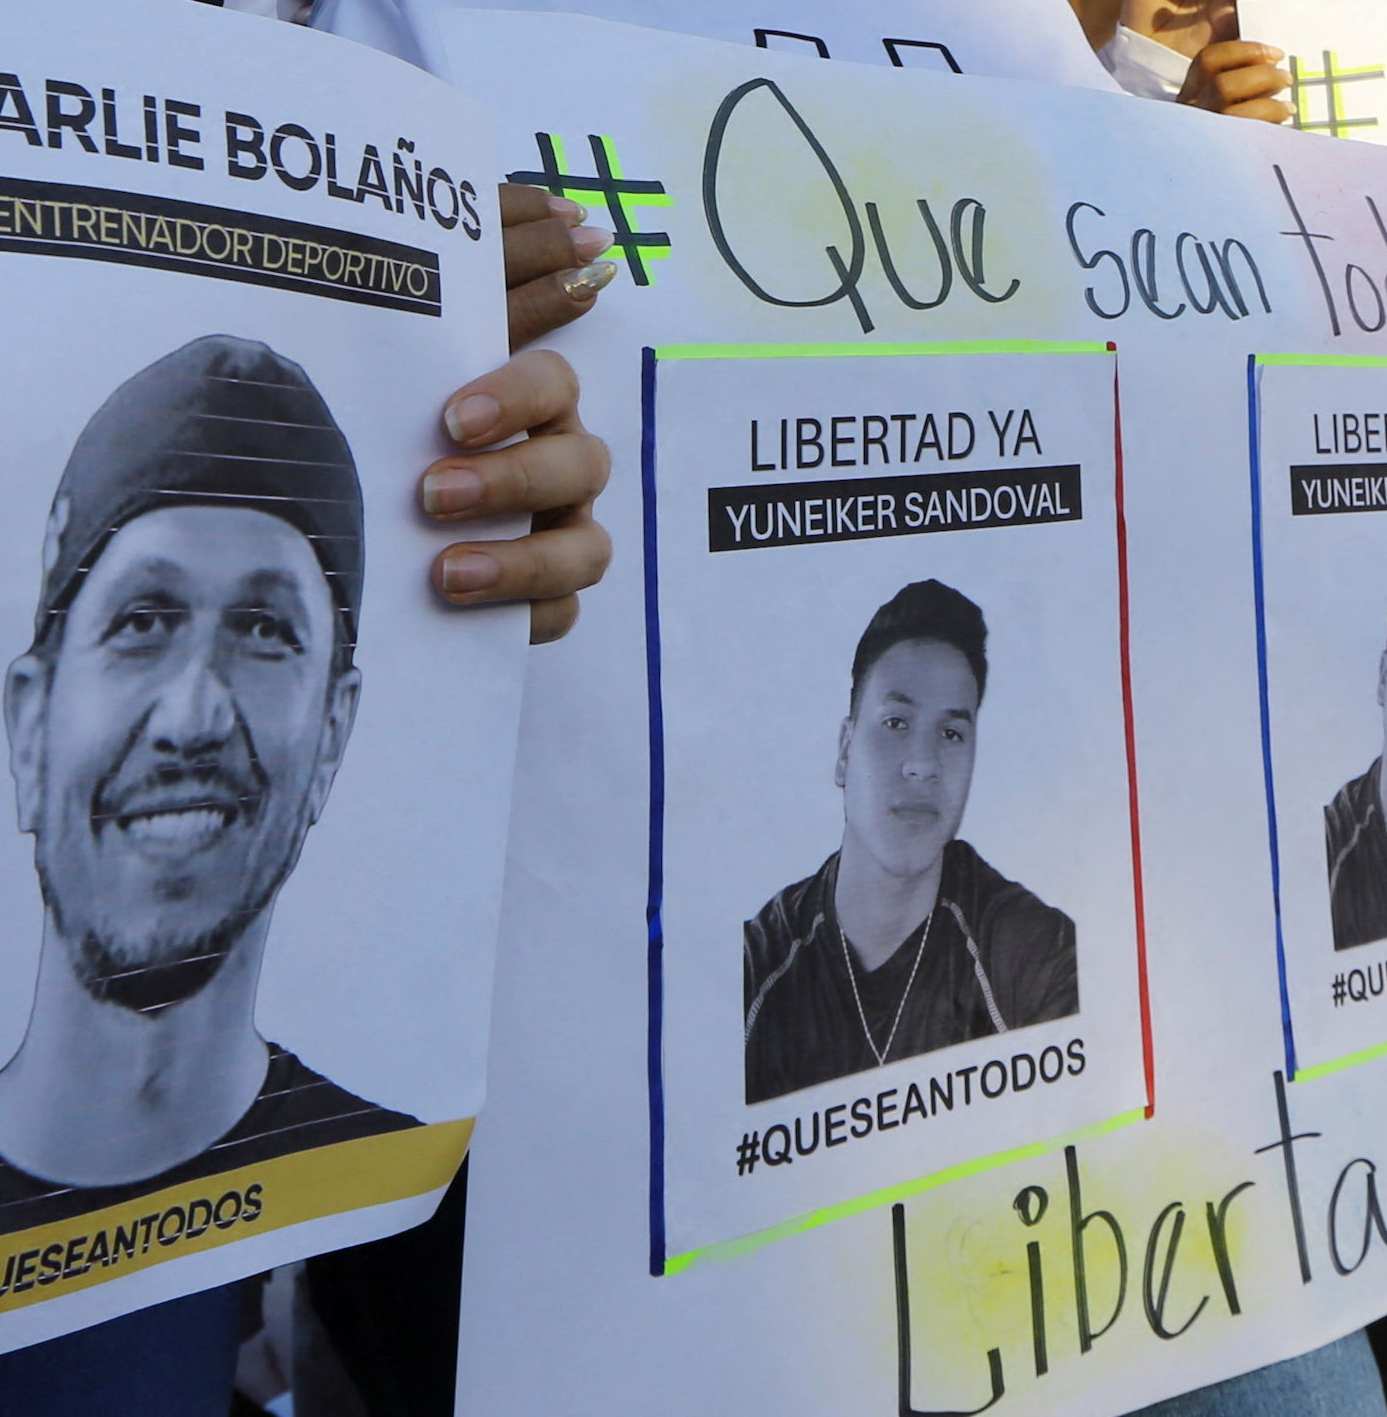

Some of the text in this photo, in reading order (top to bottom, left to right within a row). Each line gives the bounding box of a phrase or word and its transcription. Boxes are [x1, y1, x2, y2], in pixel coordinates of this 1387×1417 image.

[224, 110, 481, 241] BOLAÑOS
[262, 232, 429, 296] DEPORTIVO
[1065, 200, 1272, 320] sean
[750, 409, 1042, 472] LIBERTAD YA
[726, 482, 1070, 543] YUNEIKER SANDOVAL
[736, 1038, 1087, 1177] #QUESEANTODOS
